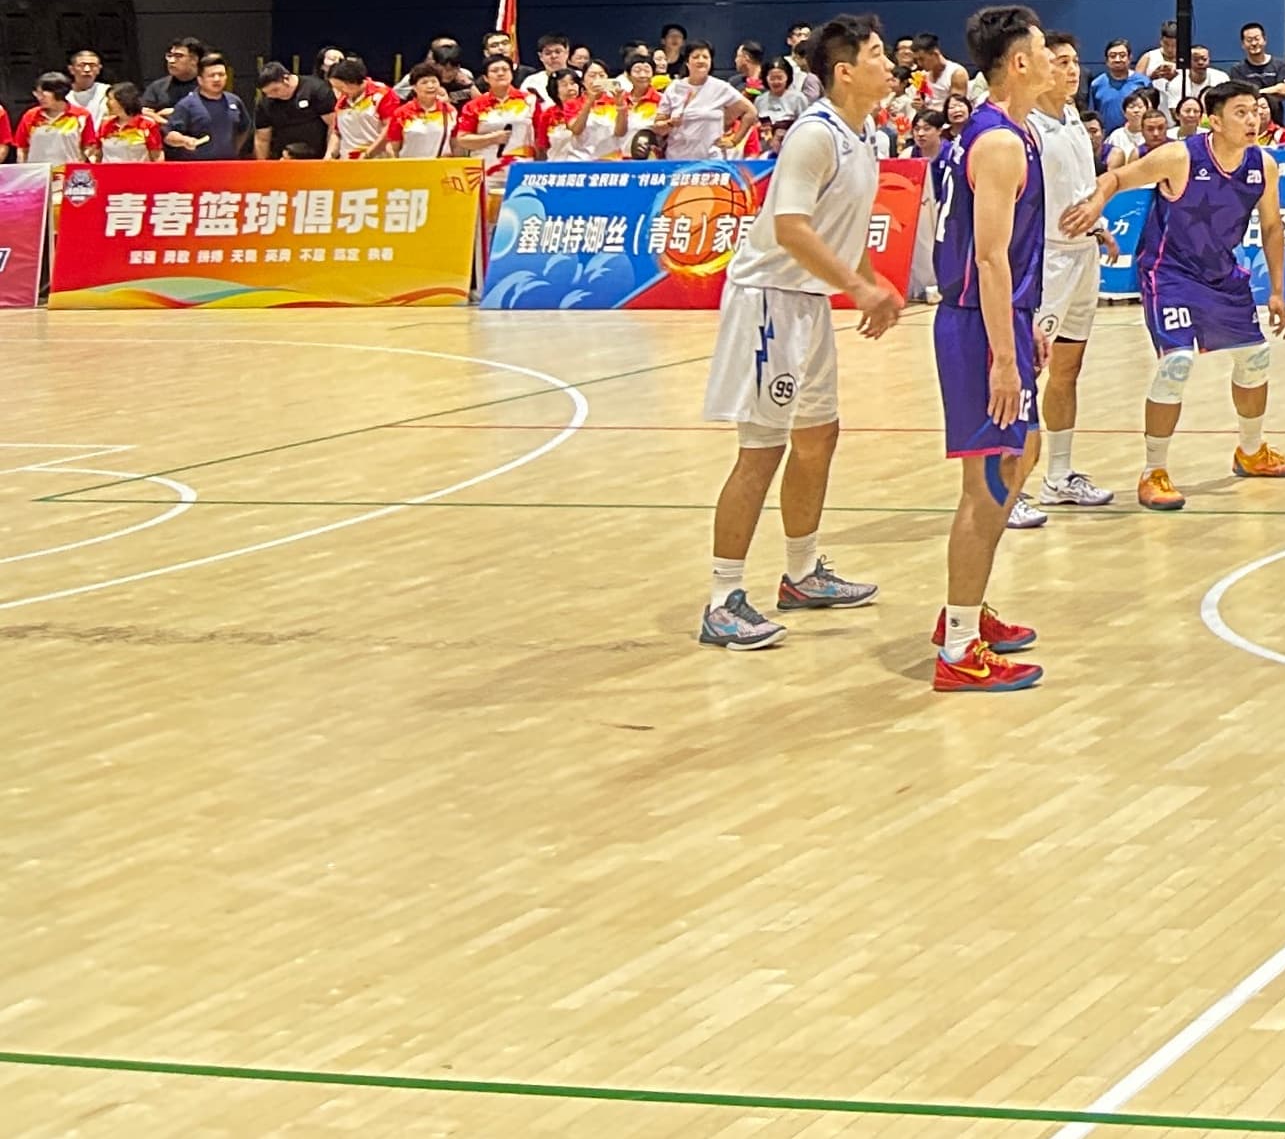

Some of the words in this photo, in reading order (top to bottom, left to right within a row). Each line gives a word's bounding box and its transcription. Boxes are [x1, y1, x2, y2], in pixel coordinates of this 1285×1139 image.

[1247, 169, 1262, 184] 20
[105, 188, 429, 237] 青春篮球俱乐部
[1163, 307, 1192, 331] 20
[774, 380, 794, 398] 99
